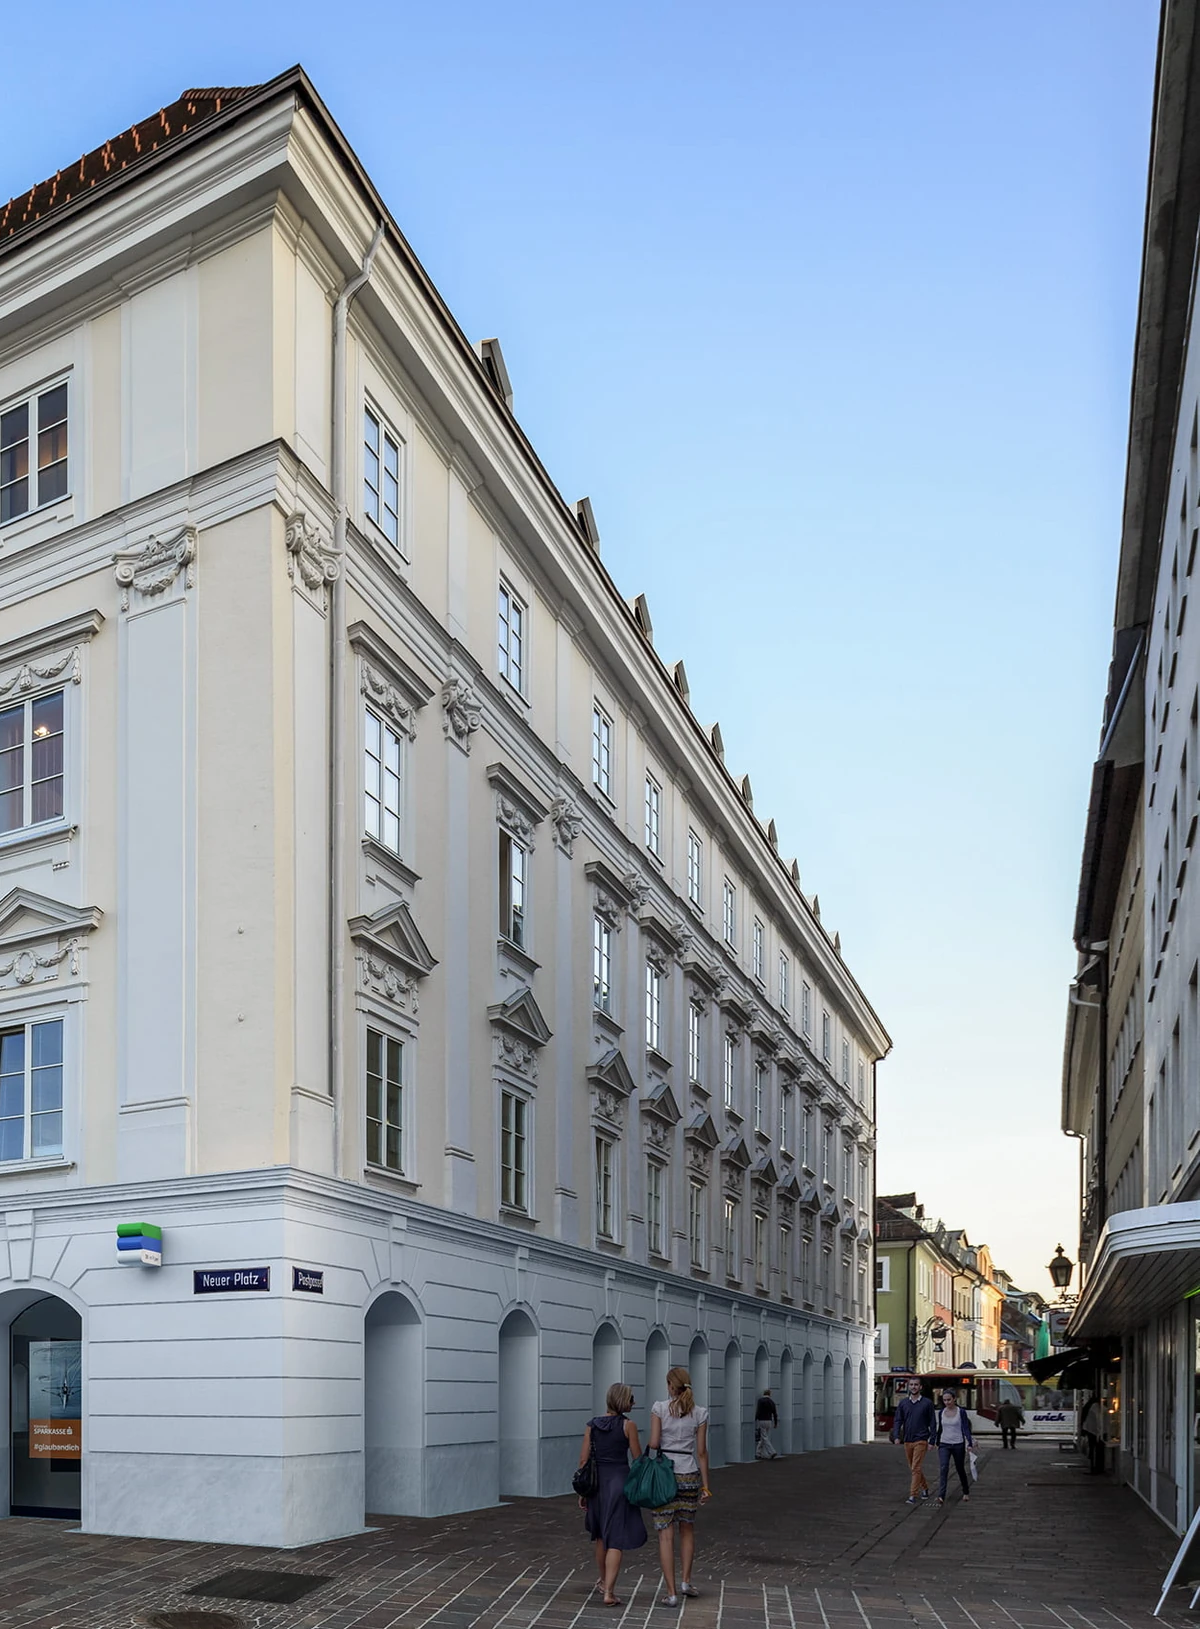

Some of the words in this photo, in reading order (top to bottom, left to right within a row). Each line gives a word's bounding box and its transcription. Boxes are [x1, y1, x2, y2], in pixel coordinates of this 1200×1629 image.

[203, 1274, 230, 1287] Neuer
[234, 1272, 259, 1286] Platz
[298, 1271, 323, 1289] Postgasse
[34, 1443, 80, 1452] #glaubandich
